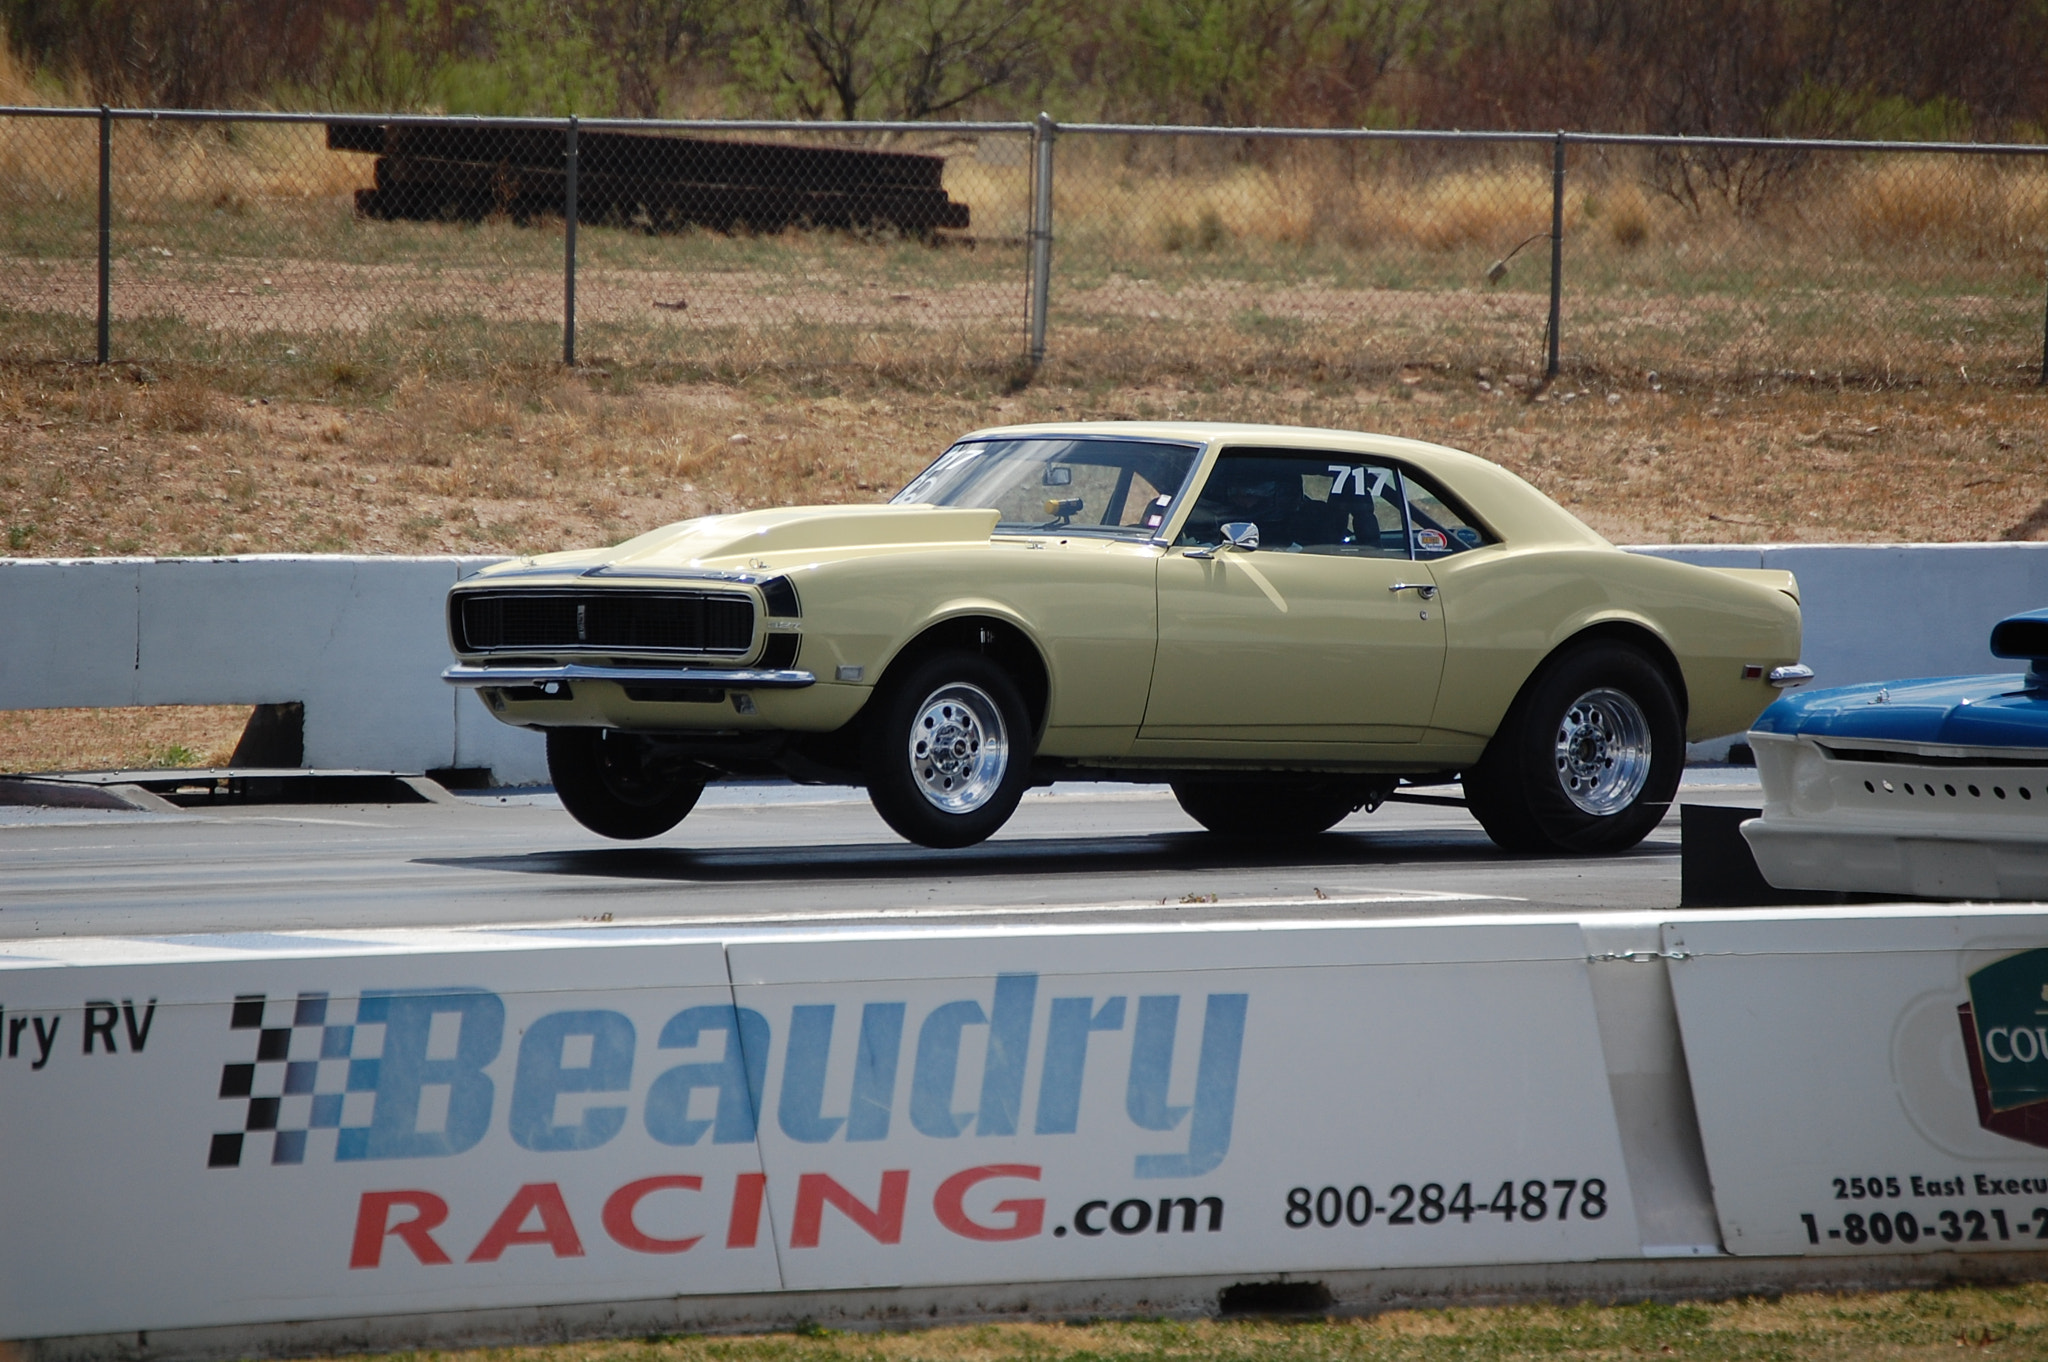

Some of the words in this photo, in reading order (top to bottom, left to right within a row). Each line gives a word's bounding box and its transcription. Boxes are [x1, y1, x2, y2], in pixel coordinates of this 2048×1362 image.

[1327, 465, 1391, 497] 717
[83, 998, 157, 1054] RV
[335, 972, 1249, 1179] Beaudry
[1285, 1178, 1608, 1229] 800-284-4878
[1832, 1177, 1901, 1199] 2505
[1910, 1175, 1965, 1197] East
[1800, 1206, 2048, 1245] 1-800-321-2
